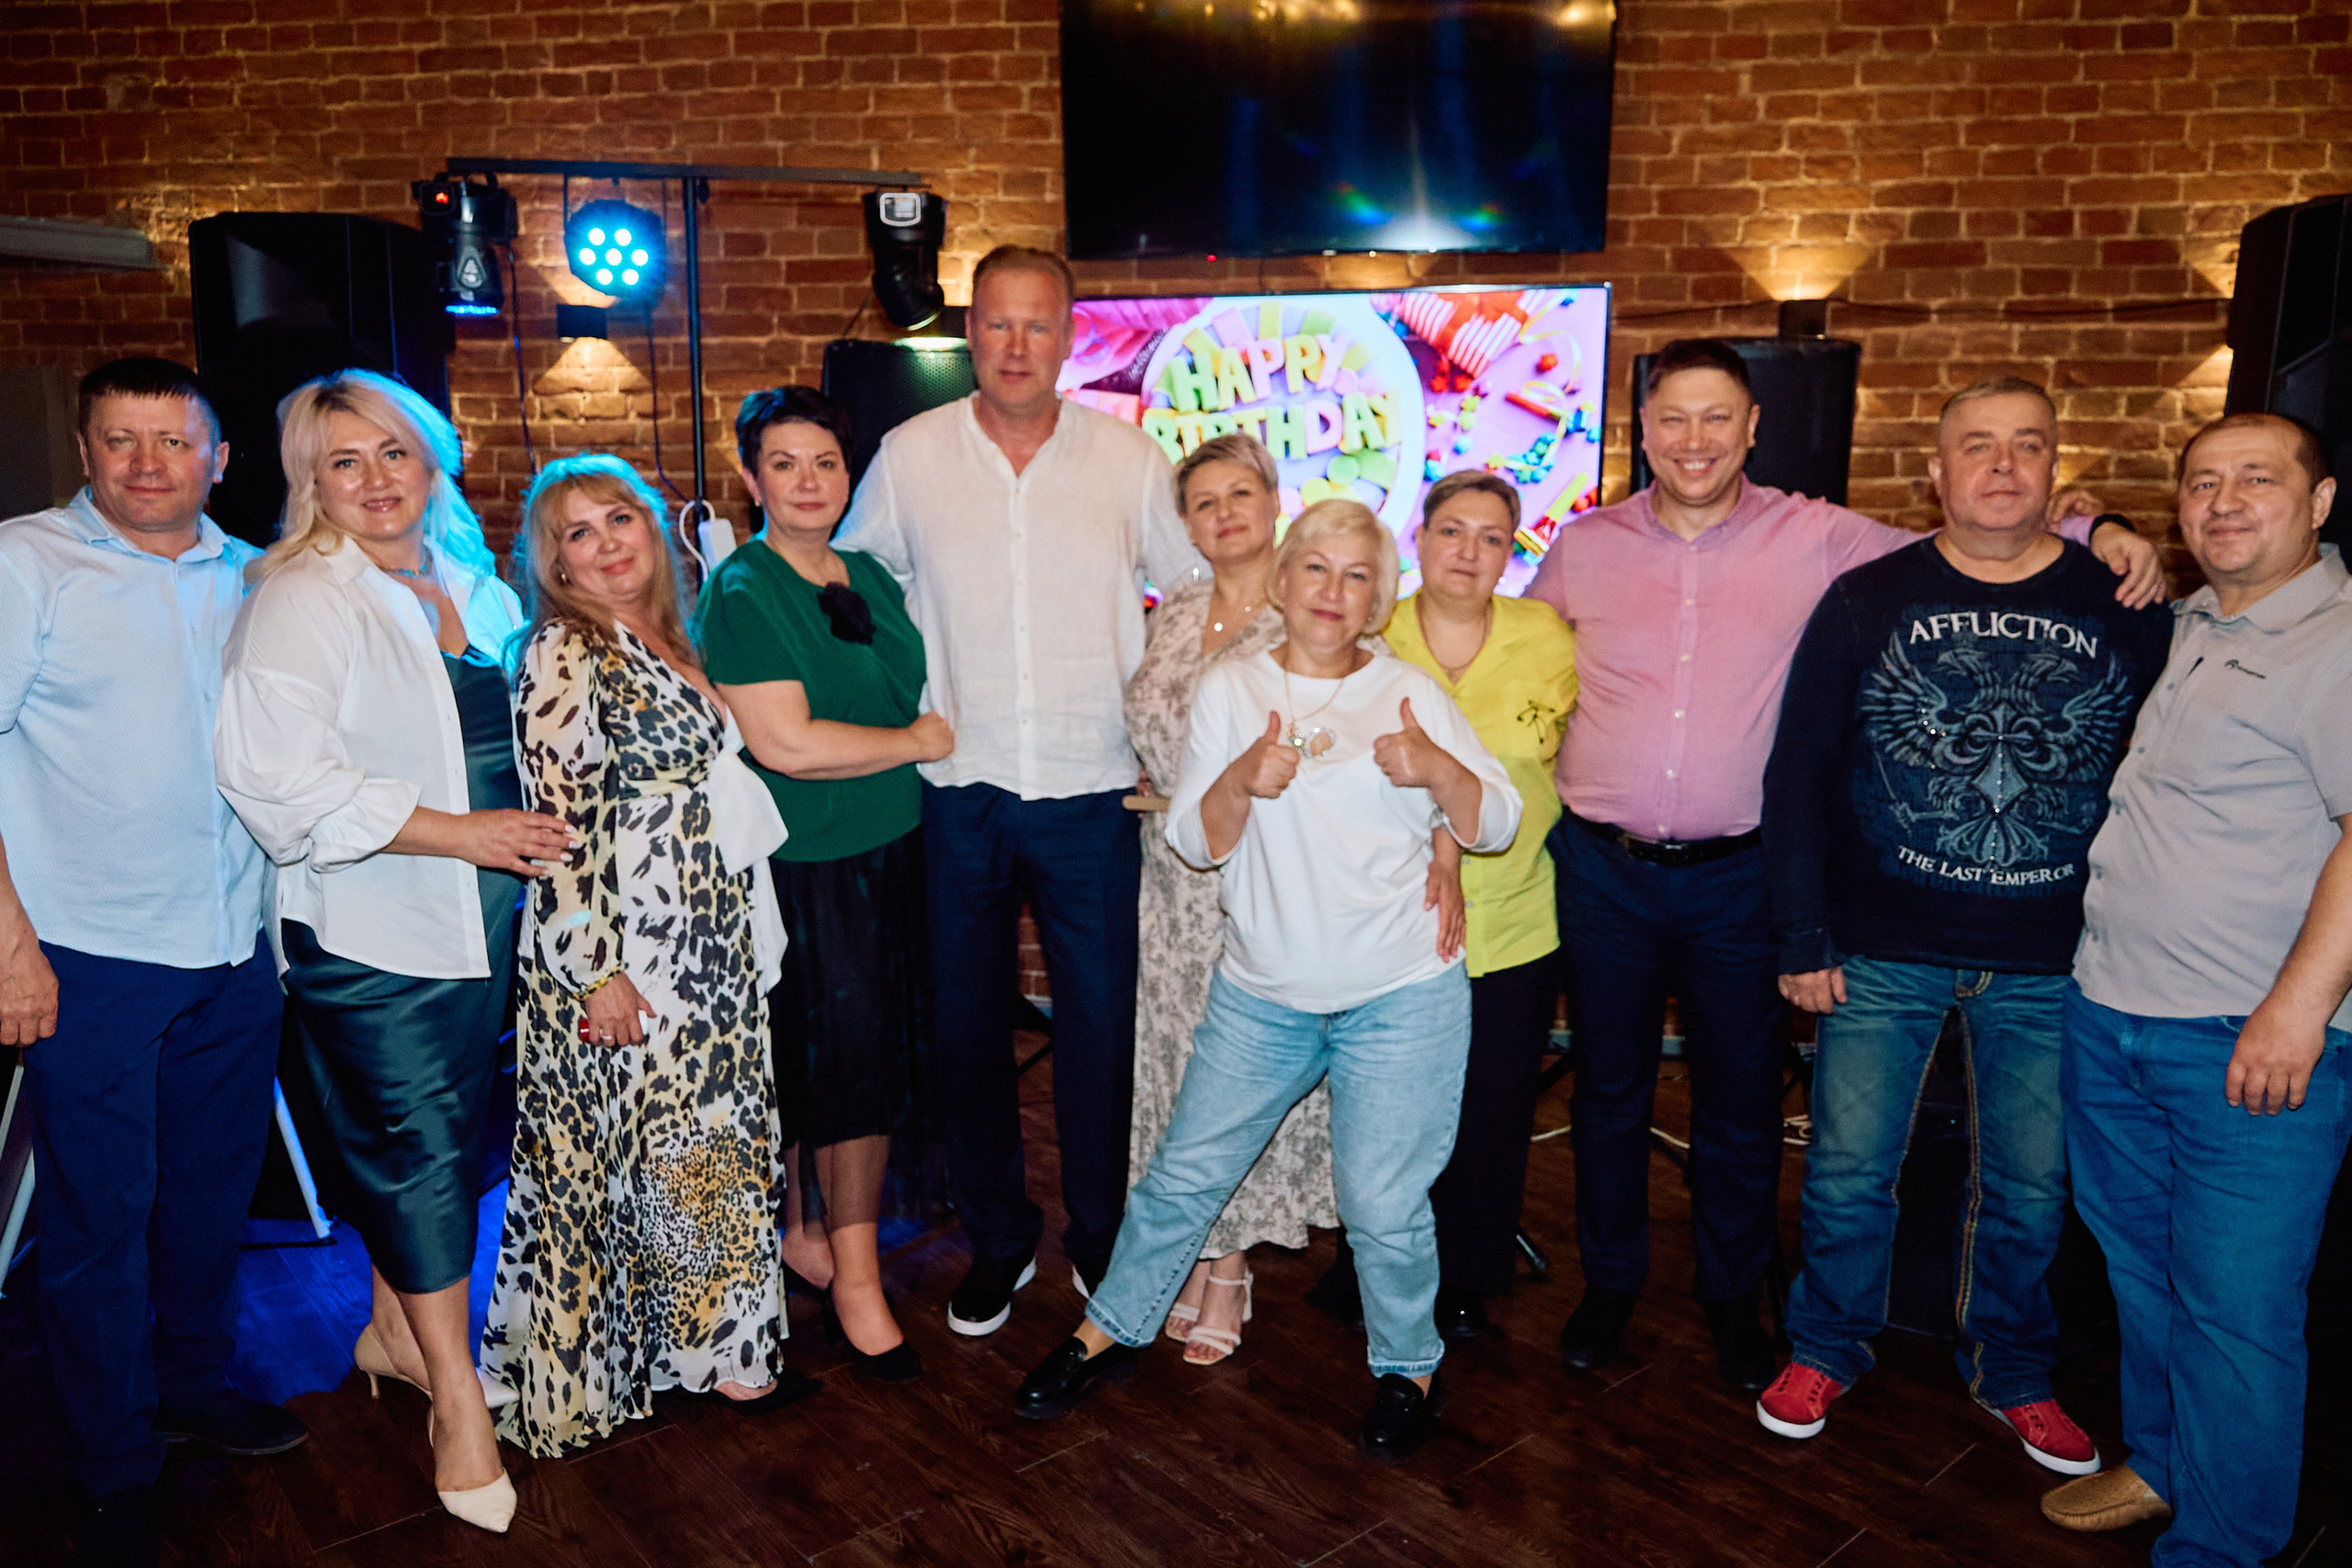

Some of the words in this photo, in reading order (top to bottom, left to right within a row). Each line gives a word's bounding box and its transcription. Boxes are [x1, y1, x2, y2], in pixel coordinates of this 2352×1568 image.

[1170, 333, 1350, 412] HAPPY
[1909, 611, 2098, 659] AFFLICTION
[1898, 845, 1936, 872] THE
[1939, 861, 1982, 882] LAST
[1990, 863, 2075, 886] EMPEROR
